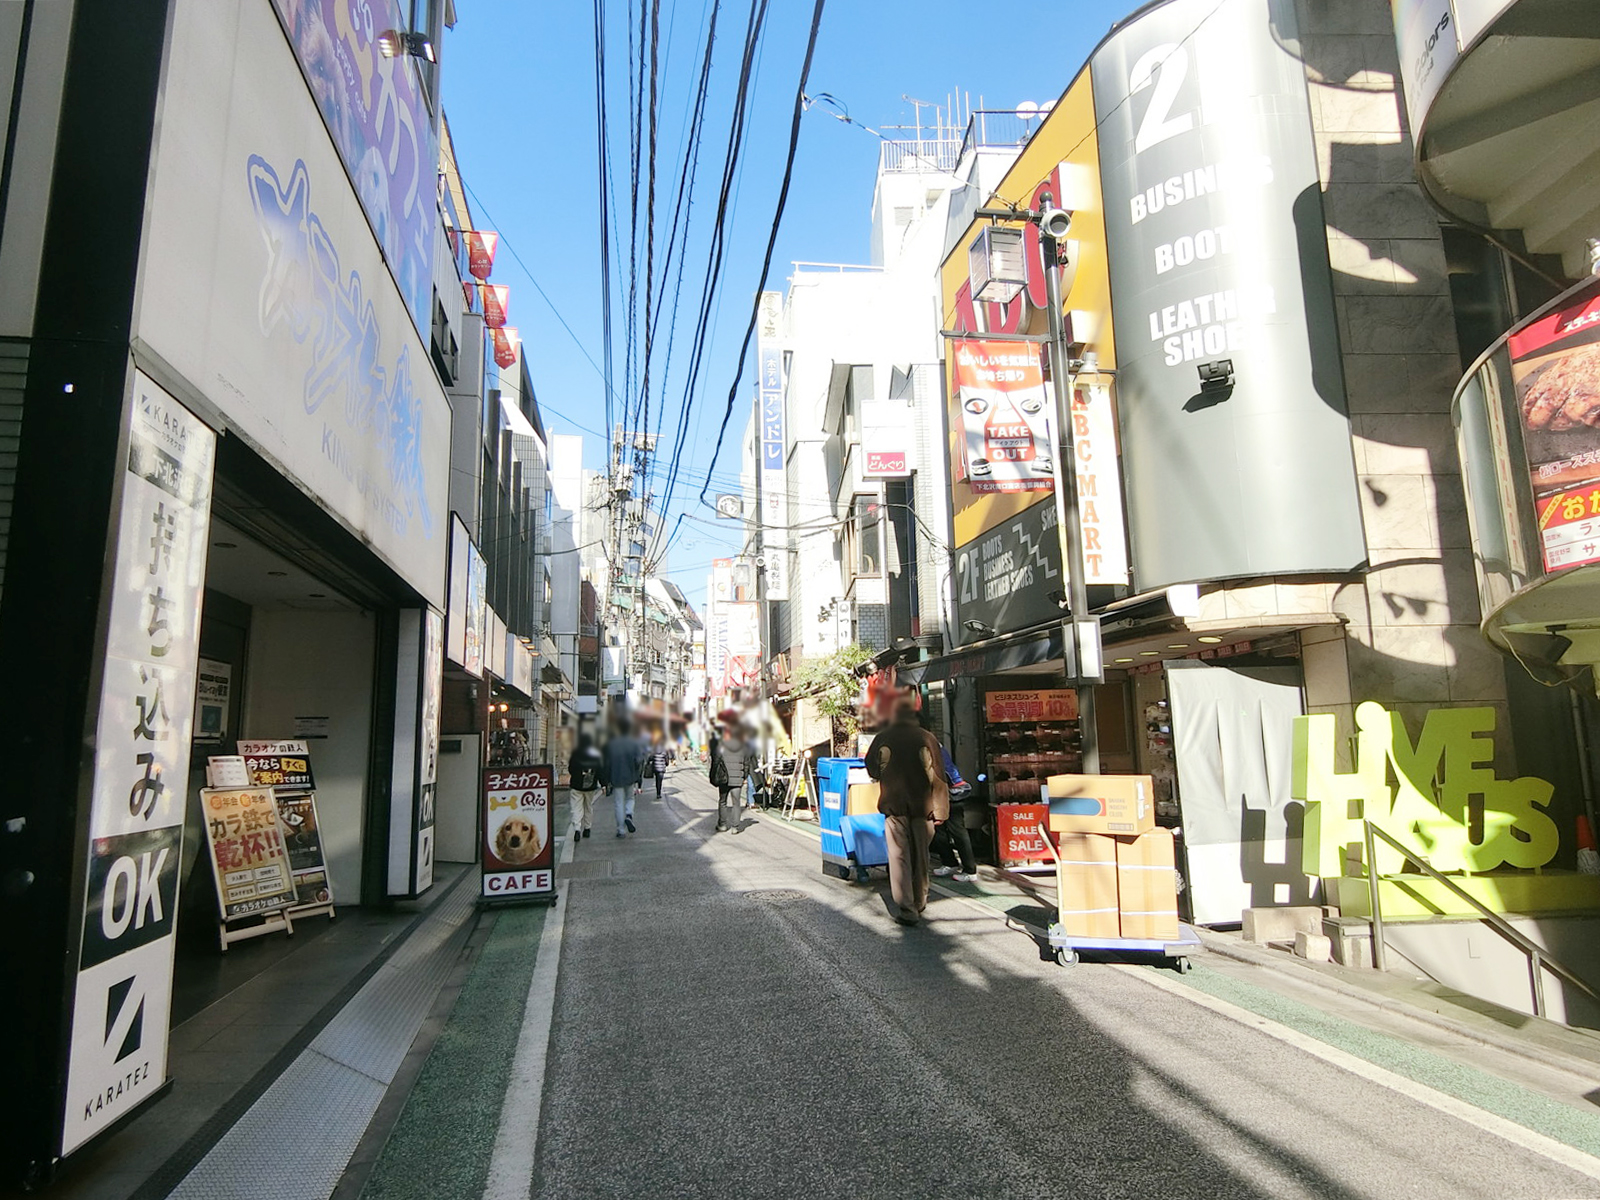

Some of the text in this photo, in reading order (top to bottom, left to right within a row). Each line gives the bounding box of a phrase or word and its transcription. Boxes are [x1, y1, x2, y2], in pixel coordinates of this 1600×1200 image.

[1130, 156, 1275, 226] BUSINS
[1155, 225, 1245, 276] BOOT
[1149, 284, 1277, 342] LEATHR
[1163, 323, 1254, 367] SHOE
[766, 359, 778, 387] ホテル
[765, 393, 781, 460] アンドレ
[987, 426, 1029, 438] TAKE
[992, 449, 1028, 460] OUT
[982, 534, 1003, 561] BOOTS
[959, 547, 980, 606] 2F
[983, 550, 1015, 582] BUSINESS
[984, 564, 1035, 602] LEATHER SHOES
[128, 501, 184, 824] 持ち込み
[990, 700, 1045, 719] 全品割引
[243, 743, 304, 753] カラオケの鉄人
[246, 757, 305, 770] 今なら すぐに
[488, 773, 549, 790] 子犬カフェ
[422, 790, 435, 823] OK
[520, 790, 547, 808] Rio
[1011, 826, 1038, 836] SALE
[1012, 812, 1035, 820] SALE
[214, 829, 284, 872] 乾杯!!
[1008, 840, 1044, 852] SALE
[101, 848, 168, 942] OK
[488, 873, 549, 892] CAFE
[83, 1062, 150, 1122] KARATEZ
